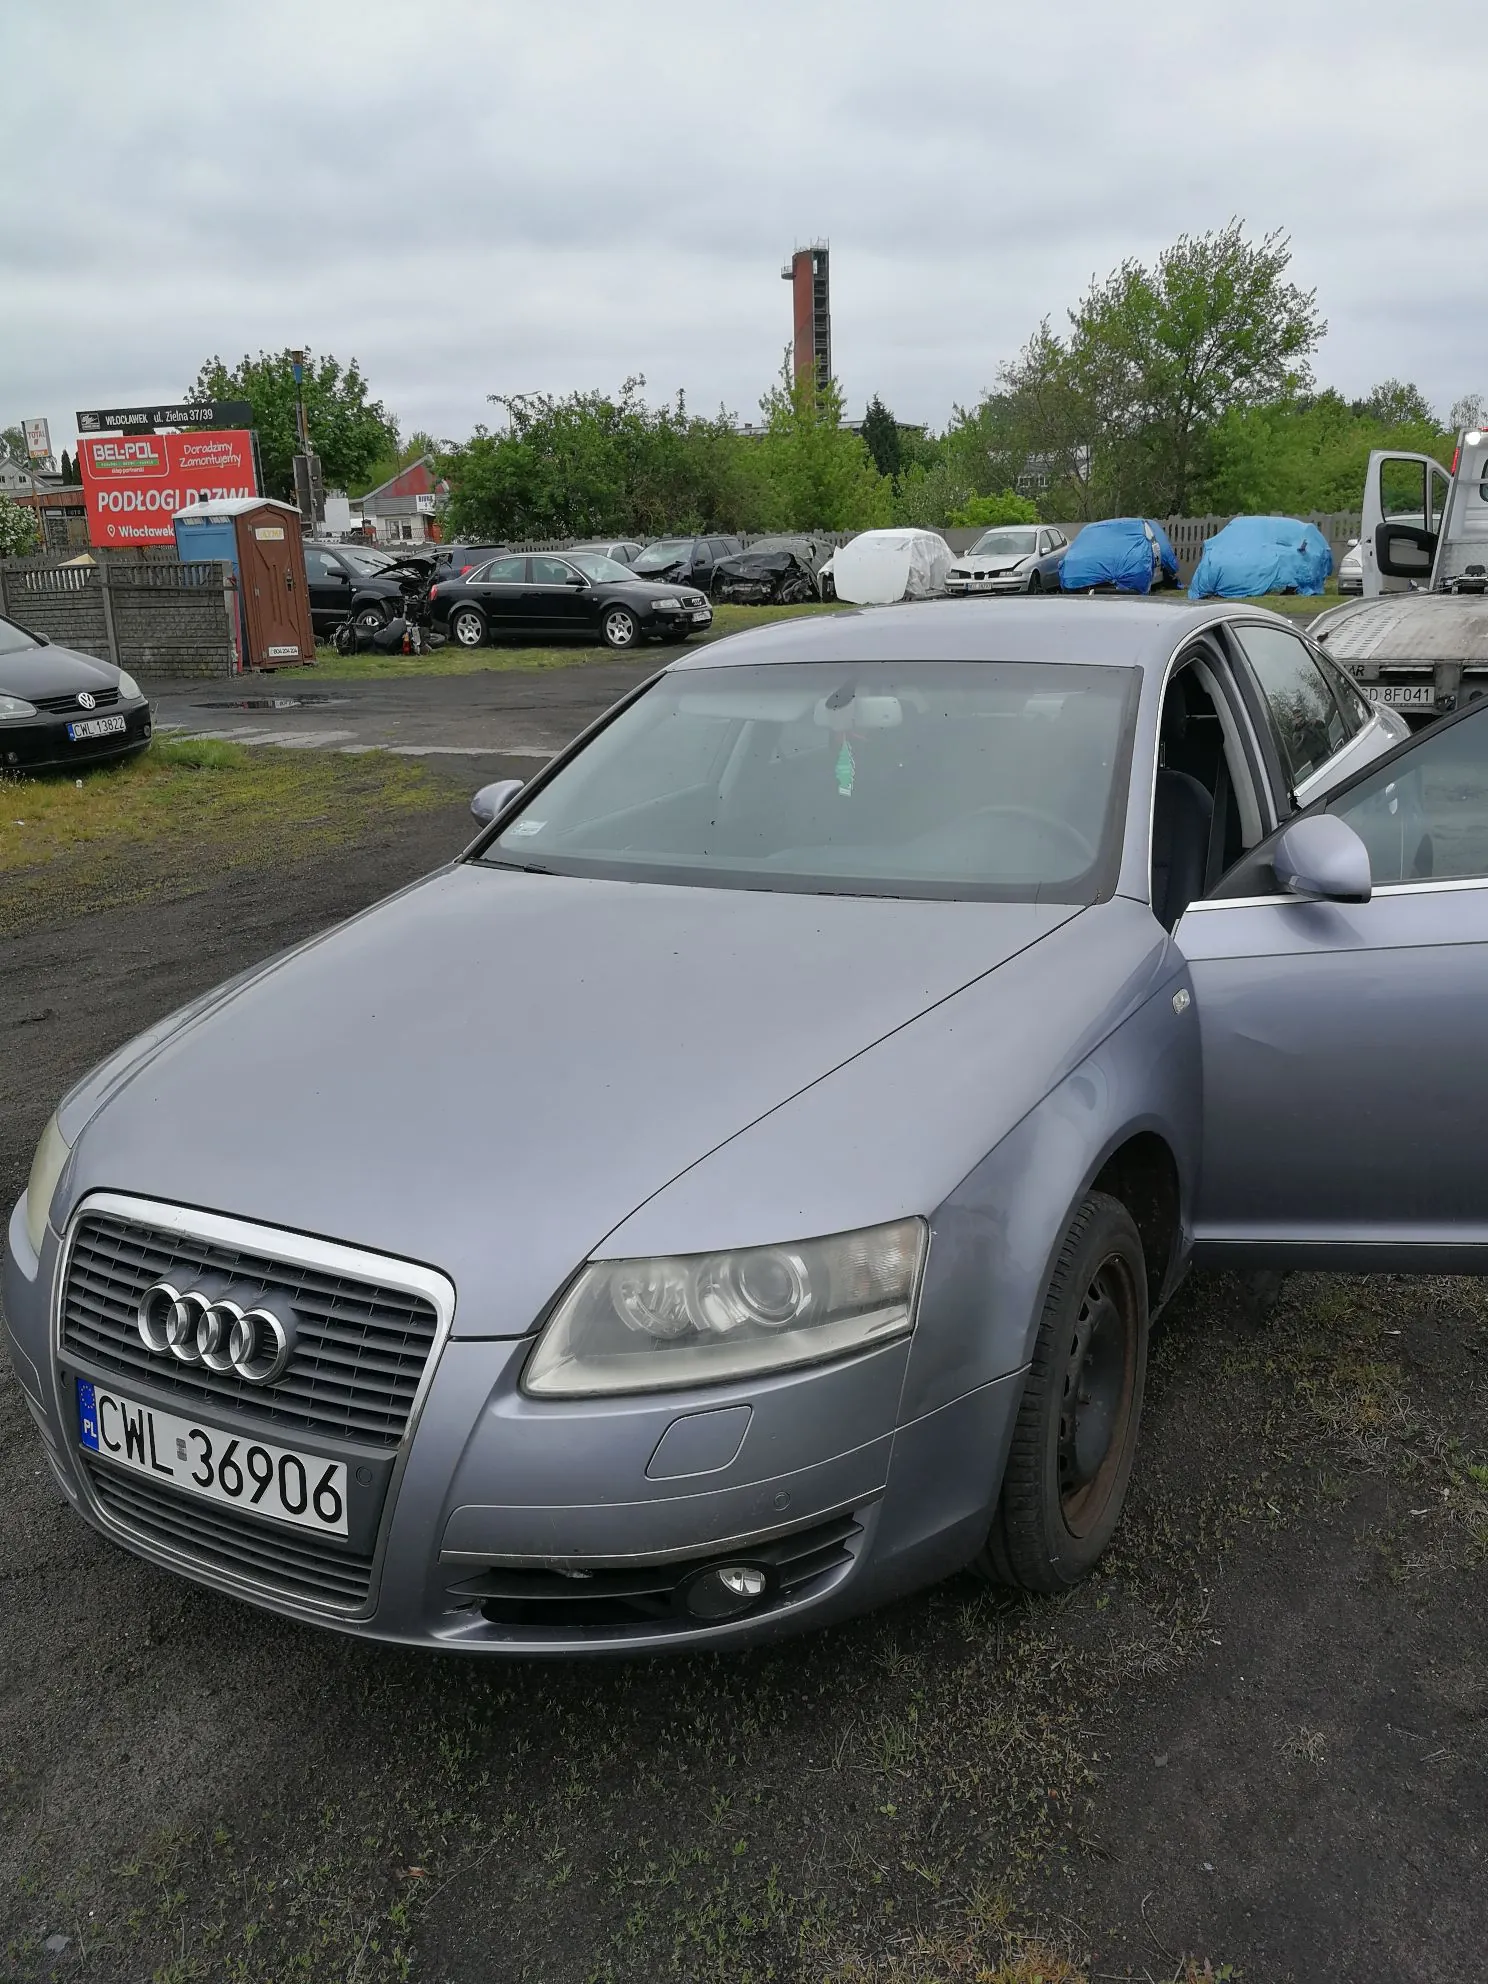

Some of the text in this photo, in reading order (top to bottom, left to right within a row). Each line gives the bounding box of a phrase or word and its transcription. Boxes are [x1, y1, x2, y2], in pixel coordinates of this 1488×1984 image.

[154, 410, 164, 423] ul.
[165, 409, 189, 422] Zielna
[189, 408, 213, 421] 37/39
[183, 440, 233, 456] Doradzimy
[179, 453, 242, 469] Zamontujemy
[98, 489, 180, 513] PODŁOGI
[1384, 688, 1429, 702] 8F041
[74, 722, 94, 737] CWL
[97, 717, 125, 733] 13822
[83, 1418, 97, 1438] PL
[99, 1395, 343, 1524] CWL 36906
